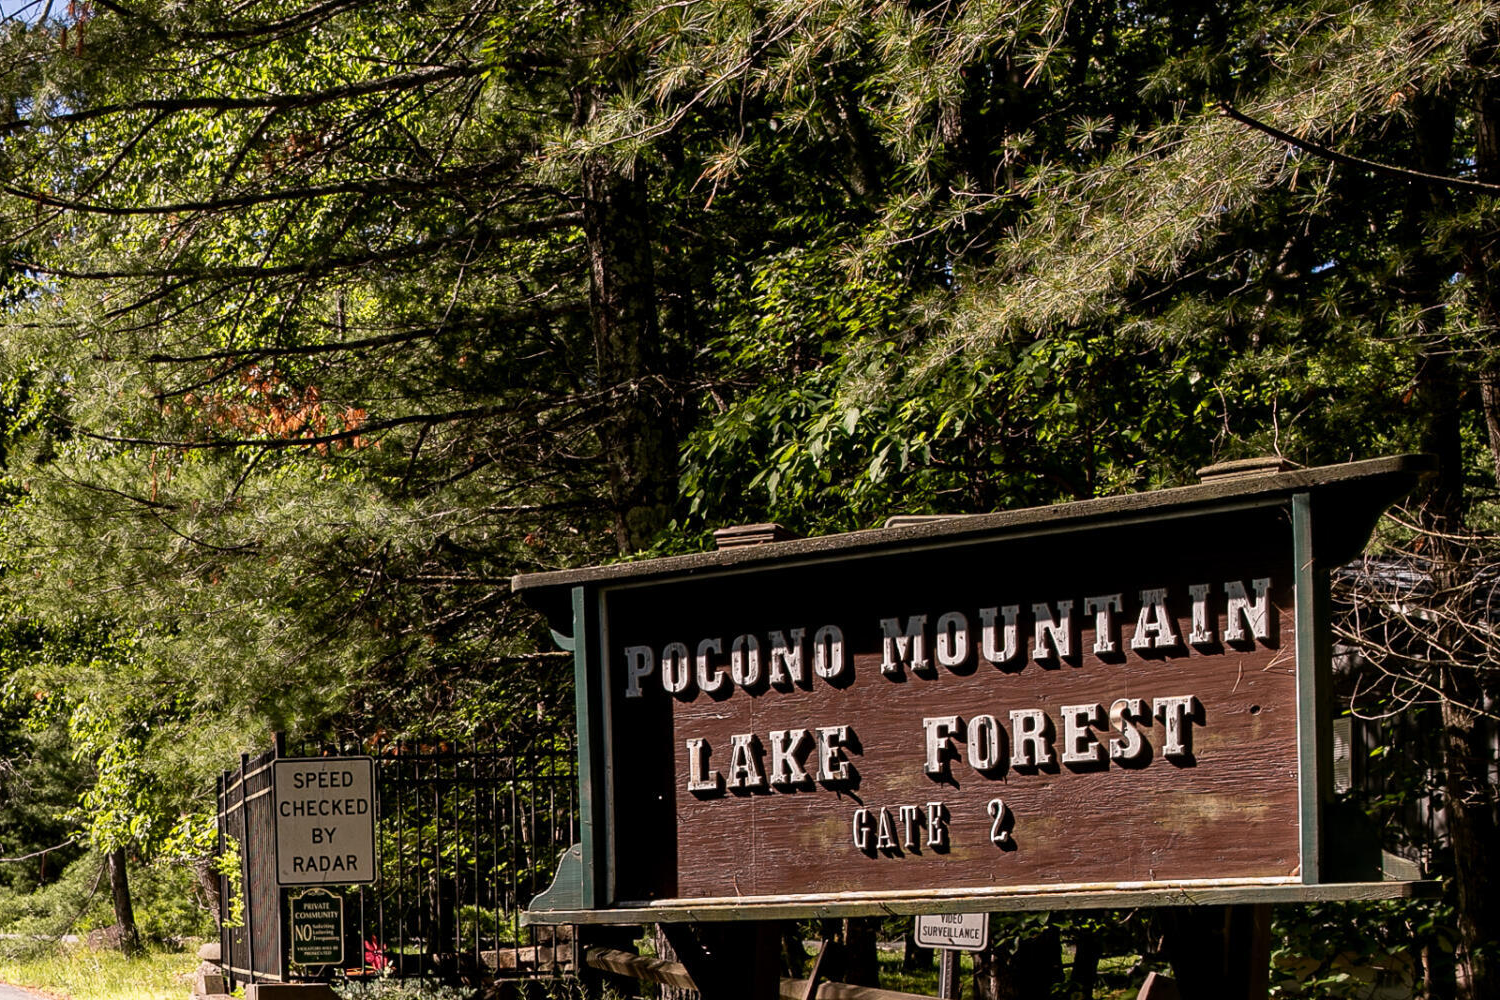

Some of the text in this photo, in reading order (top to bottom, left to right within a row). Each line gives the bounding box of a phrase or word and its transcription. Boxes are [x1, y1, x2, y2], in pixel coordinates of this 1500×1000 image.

[624, 577, 1272, 698] POCONO MOUNTAIN
[687, 694, 1196, 791] LAKE FOREST
[293, 771, 354, 788] SPEED
[280, 798, 369, 817] CHECKED
[853, 799, 1008, 849] GATE 2
[312, 827, 337, 844] BY
[293, 854, 358, 873] RADAR
[304, 902, 329, 910] PRIVATE
[295, 911, 338, 919] COMMUNITY
[940, 914, 963, 924] VIDEO
[295, 924, 313, 941] NO
[922, 926, 980, 940] SURVEILLANCE
